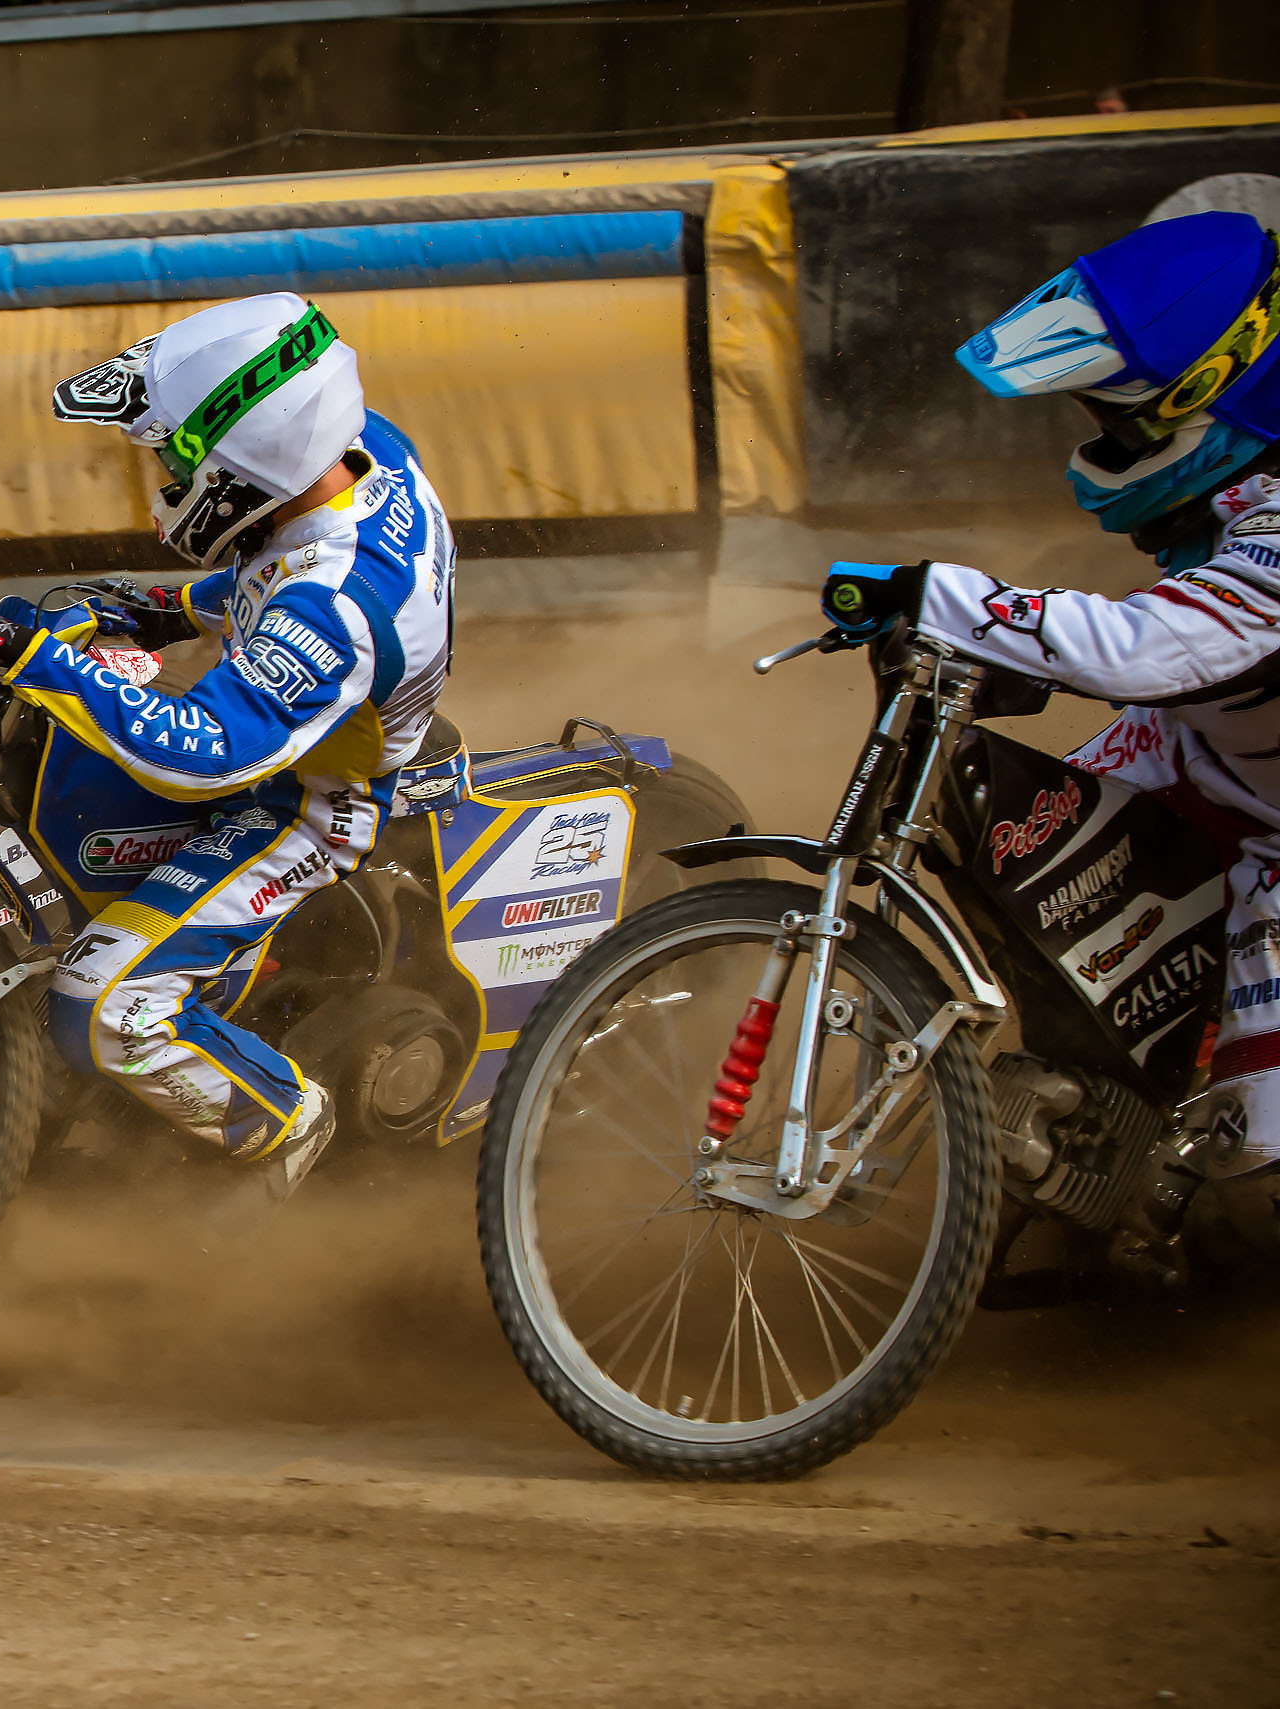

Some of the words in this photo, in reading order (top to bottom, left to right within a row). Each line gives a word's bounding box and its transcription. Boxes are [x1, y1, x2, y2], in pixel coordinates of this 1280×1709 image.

[202, 311, 330, 437] SCOT
[131, 720, 225, 756] BANK
[113, 832, 190, 865] Castro
[503, 891, 601, 926] UNIFILTER
